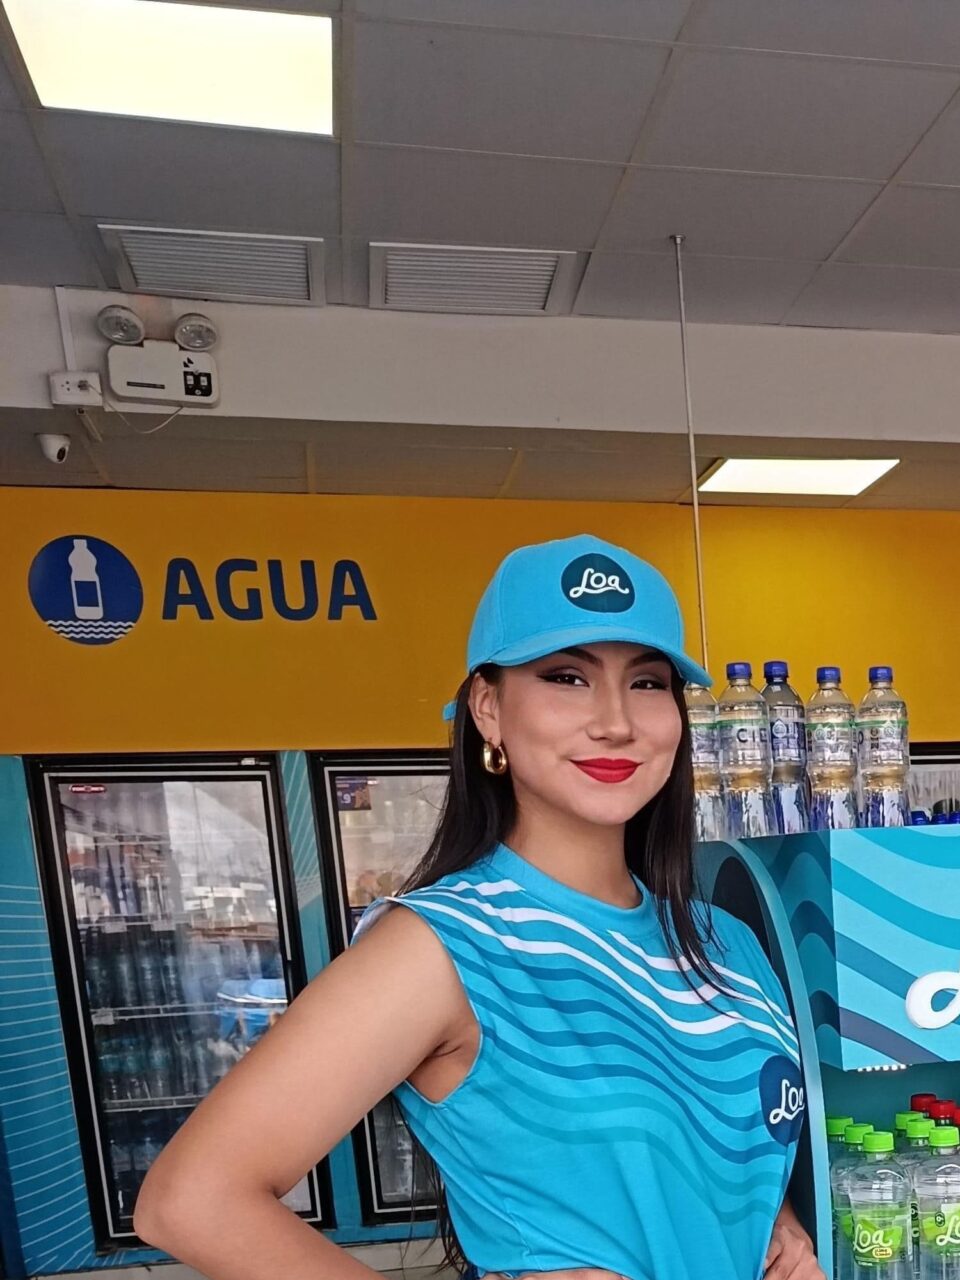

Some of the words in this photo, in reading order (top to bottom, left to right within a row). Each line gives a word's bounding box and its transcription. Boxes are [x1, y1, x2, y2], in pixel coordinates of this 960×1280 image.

[162, 557, 377, 621] AGUA
[569, 567, 630, 598] Loa
[853, 1224, 893, 1254] Loa
